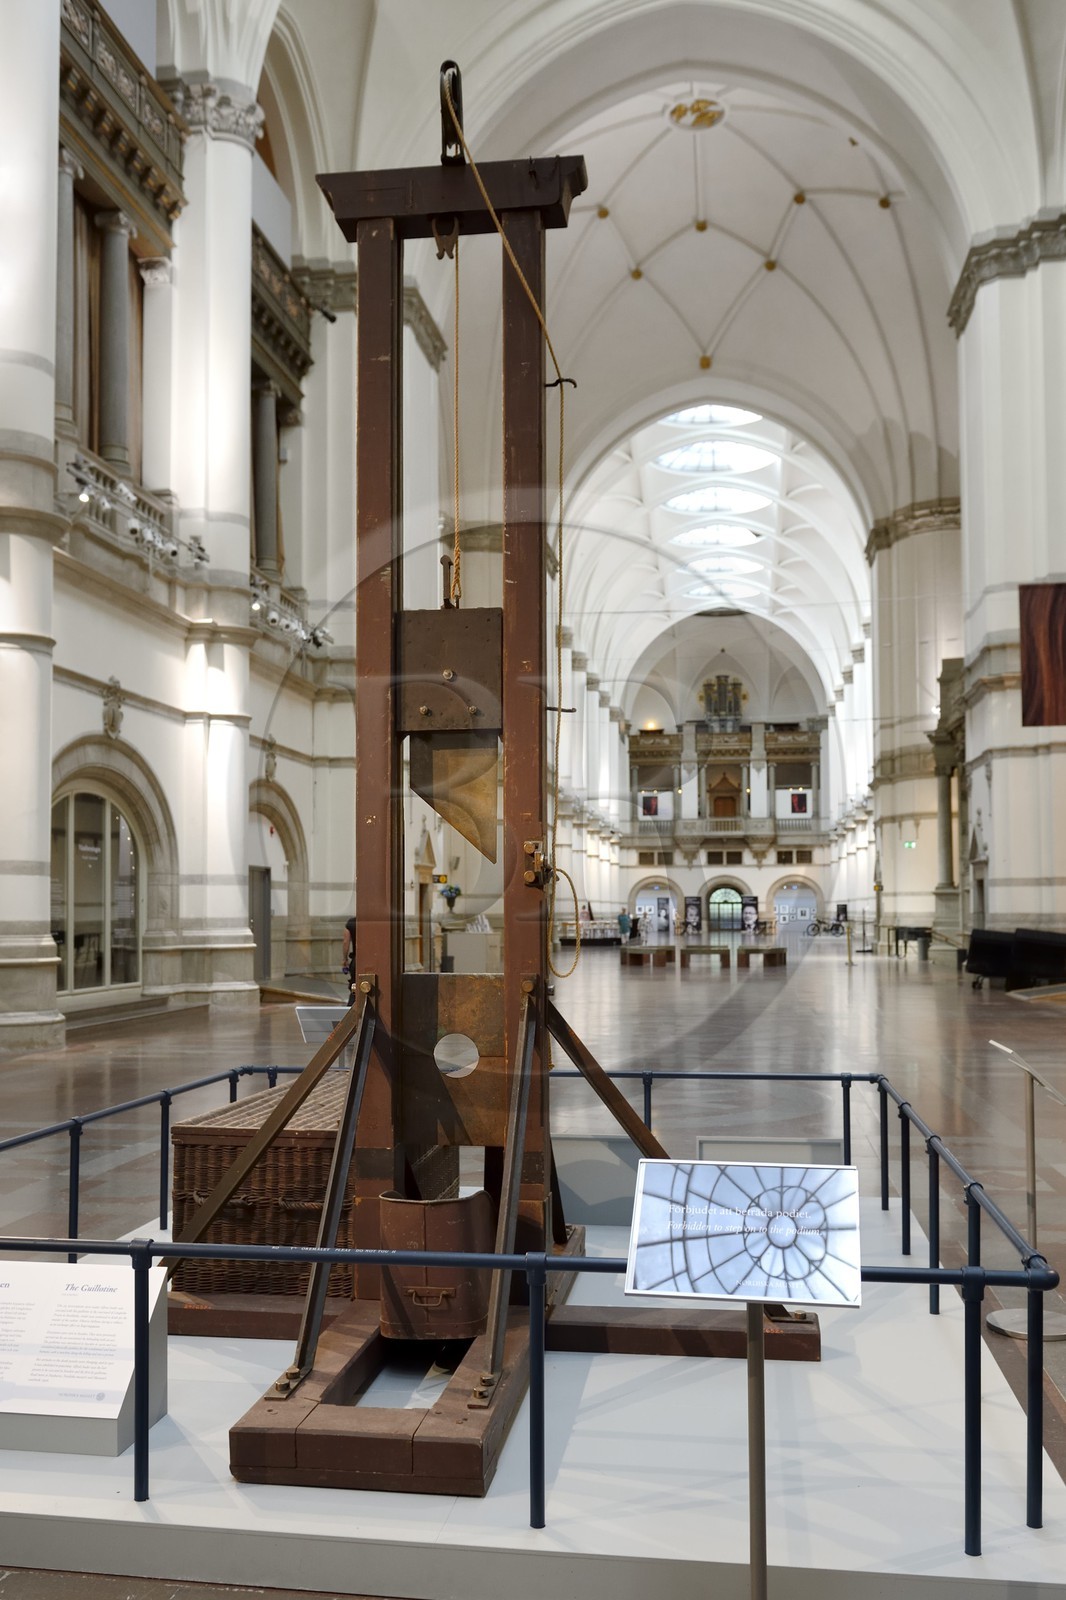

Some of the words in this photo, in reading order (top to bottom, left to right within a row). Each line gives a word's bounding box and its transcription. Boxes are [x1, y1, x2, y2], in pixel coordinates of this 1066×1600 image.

[719, 1207, 733, 1215] att
[667, 1221, 711, 1232] Forbidden
[713, 1224, 724, 1232] to
[725, 1224, 743, 1235] step
[759, 1226, 768, 1234] to
[770, 1225, 783, 1234] the
[785, 1226, 823, 1237] podium.
[81, 1284, 119, 1293] Guillotine
